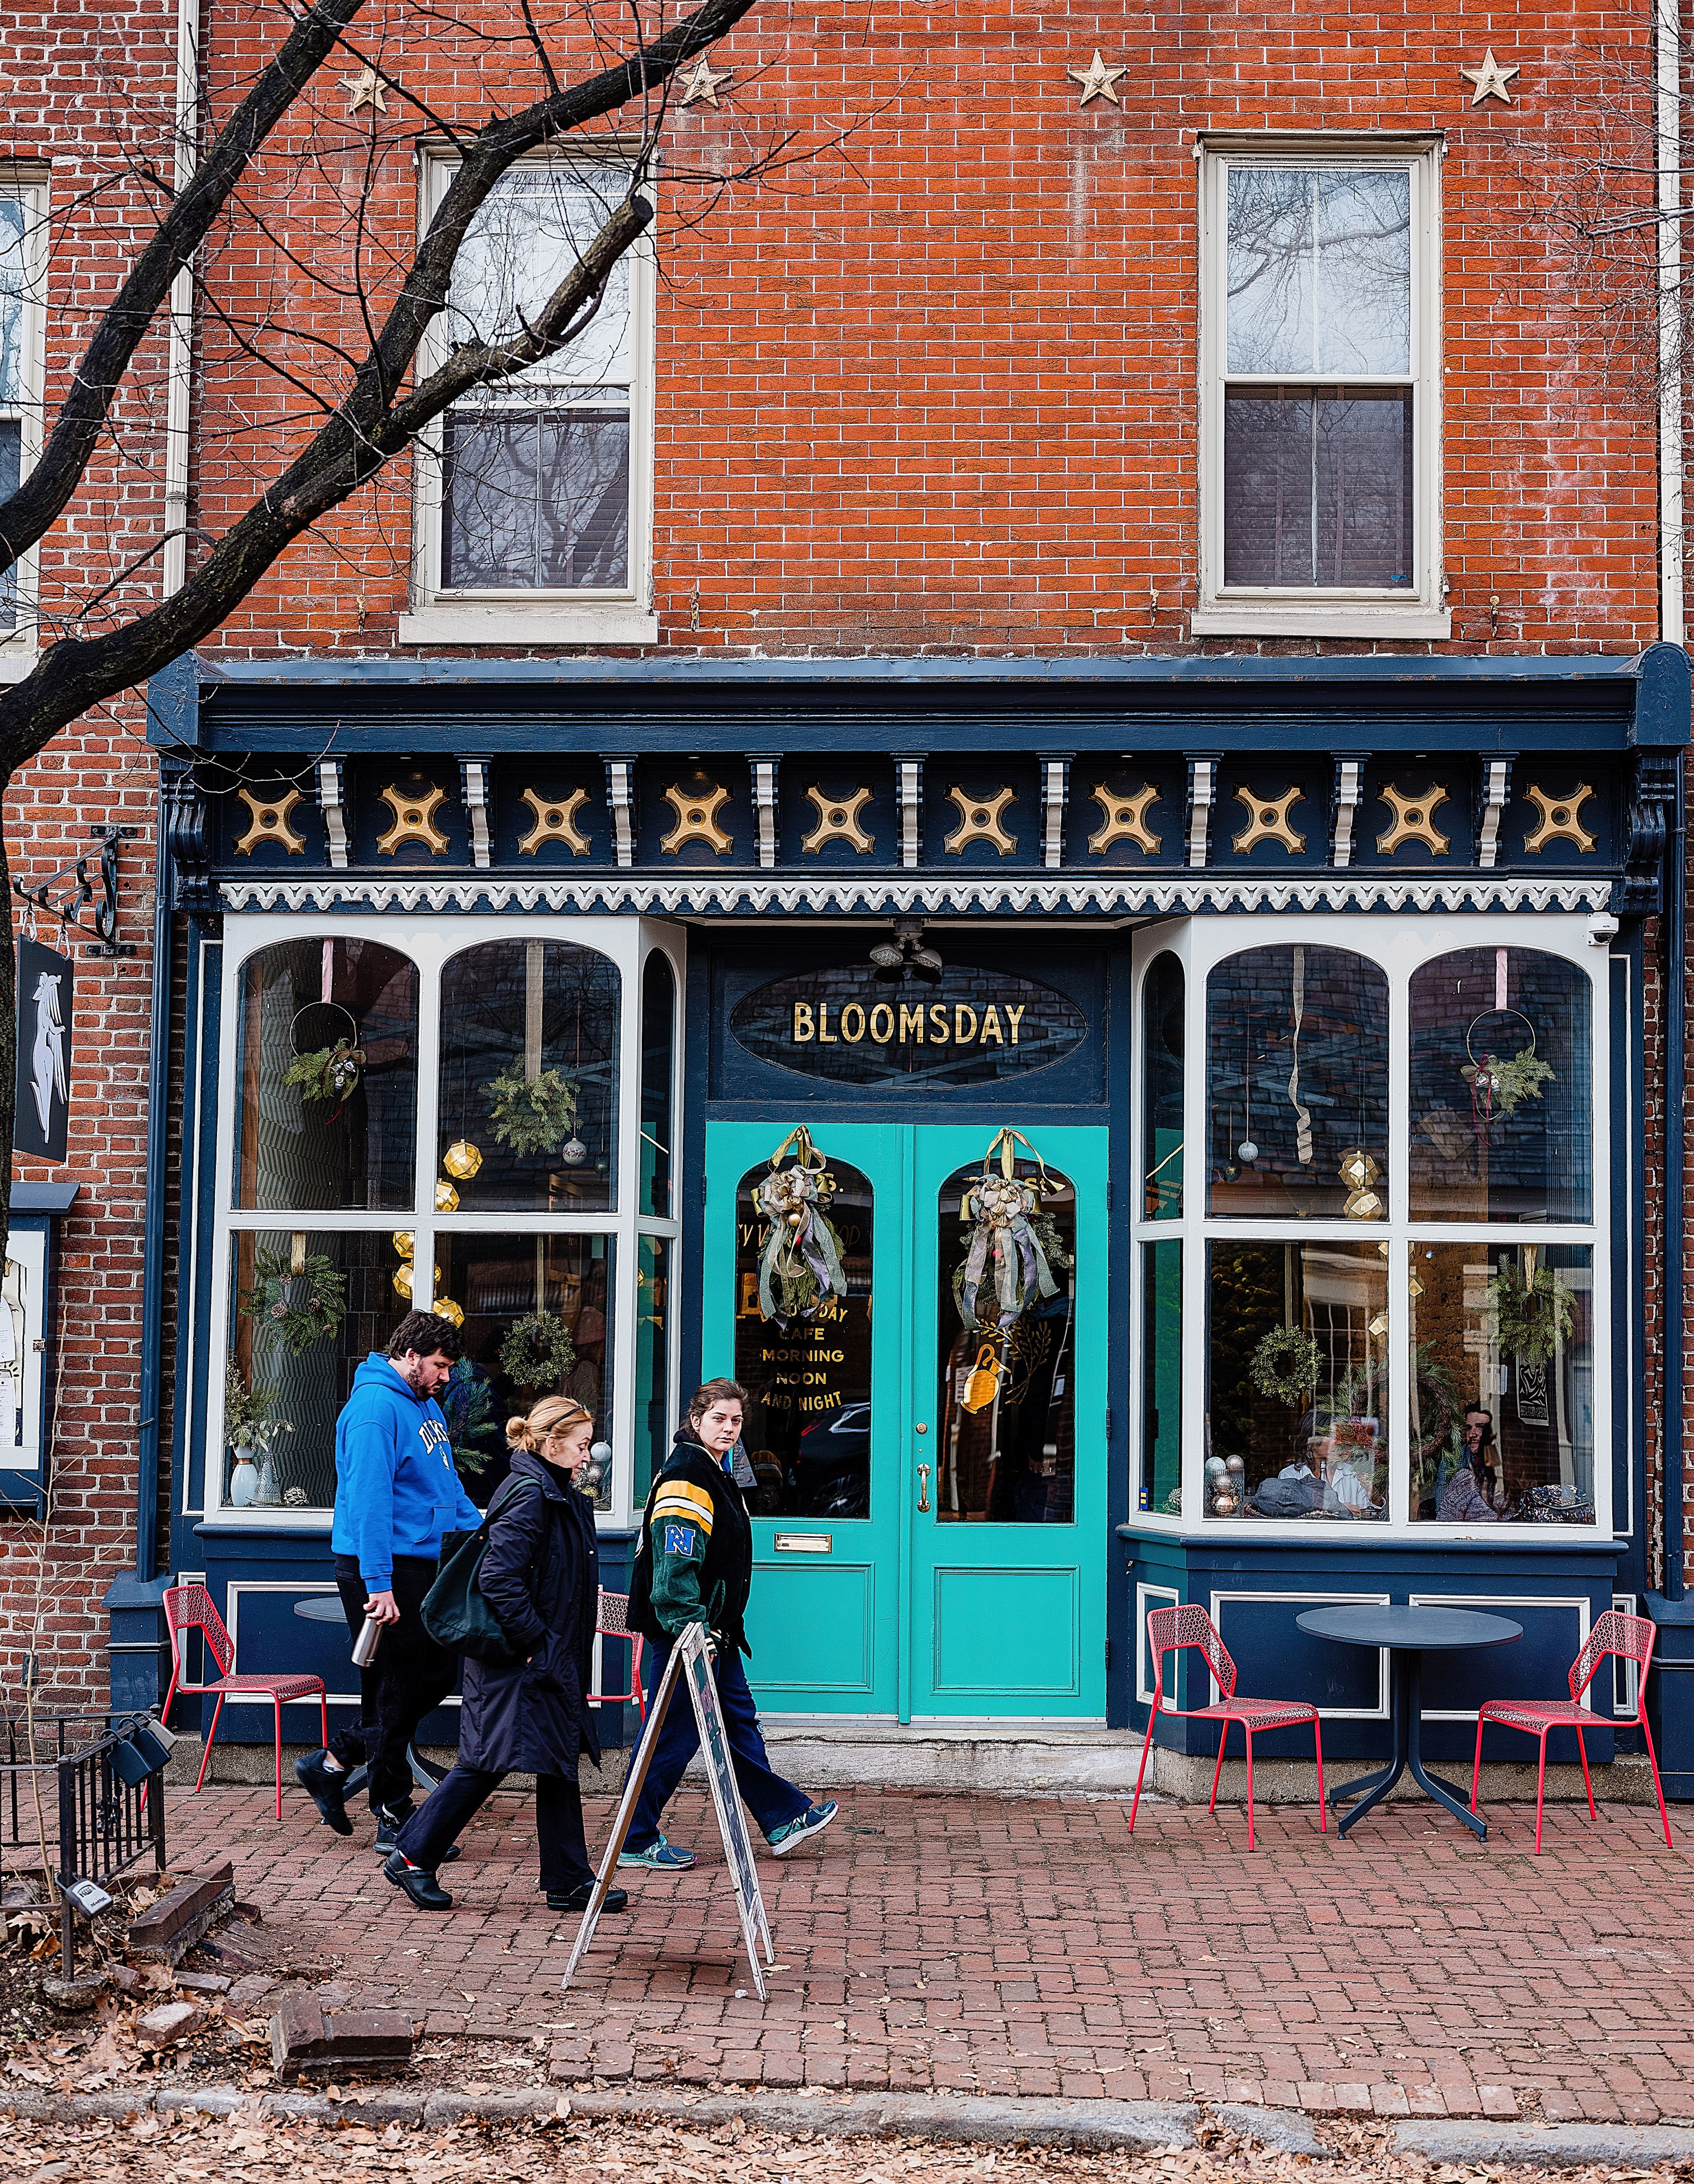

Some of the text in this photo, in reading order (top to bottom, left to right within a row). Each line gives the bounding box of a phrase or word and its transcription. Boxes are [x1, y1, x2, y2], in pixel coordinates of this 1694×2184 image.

[792, 1002, 1026, 1045] BLOOMSDAY
[779, 1328, 825, 1340] CAFE
[763, 1349, 844, 1362] MORNING
[776, 1372, 826, 1385] NOON
[761, 1391, 842, 1411] AND NIGHT
[665, 1525, 696, 1556] N
